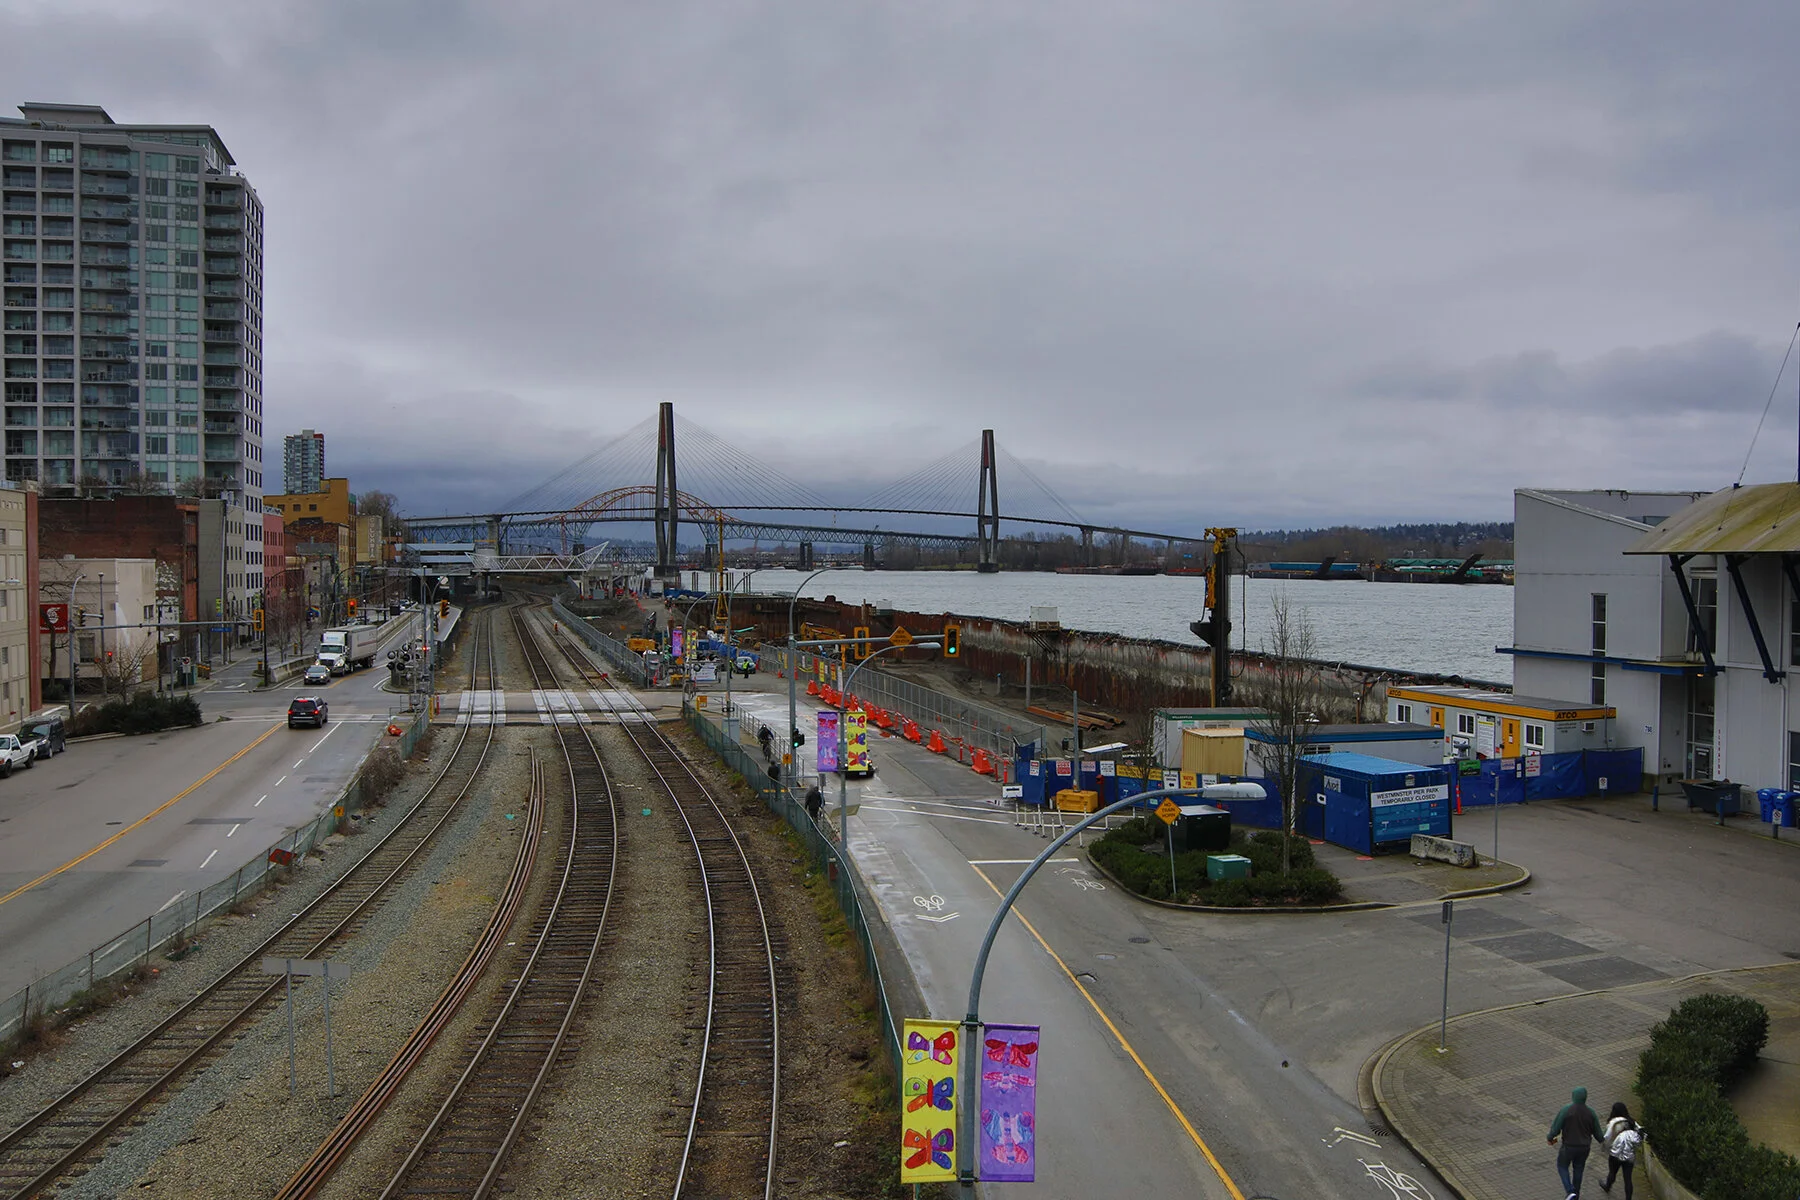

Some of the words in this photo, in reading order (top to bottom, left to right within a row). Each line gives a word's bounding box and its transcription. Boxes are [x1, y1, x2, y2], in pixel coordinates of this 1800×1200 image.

[1556, 711, 1577, 719] ATCO
[1376, 790, 1412, 799] WESTMINSTER
[1380, 796, 1414, 805] TEMPORARILY
